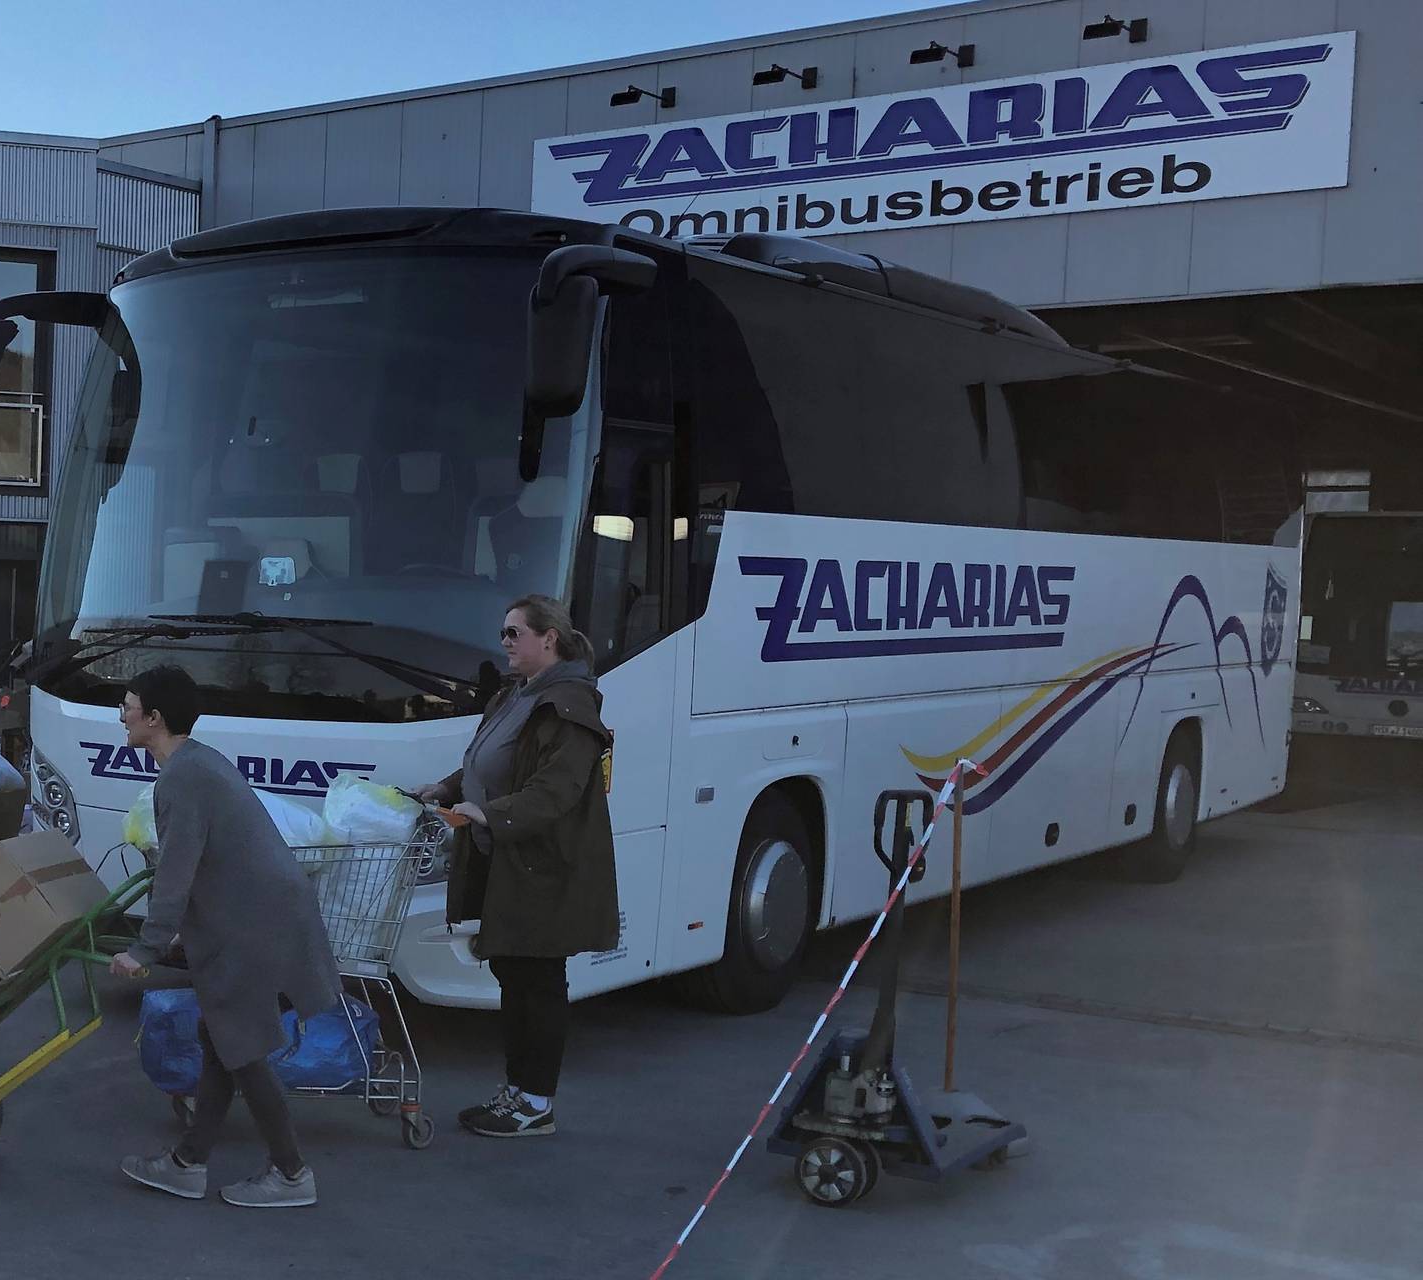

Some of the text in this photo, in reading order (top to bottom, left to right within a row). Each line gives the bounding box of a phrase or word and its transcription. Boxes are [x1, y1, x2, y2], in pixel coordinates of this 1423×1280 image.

[548, 43, 1333, 205] ZACHARIAS
[619, 154, 1213, 240] Omnibusbetrieb
[738, 556, 1075, 662] ZACHARIAS
